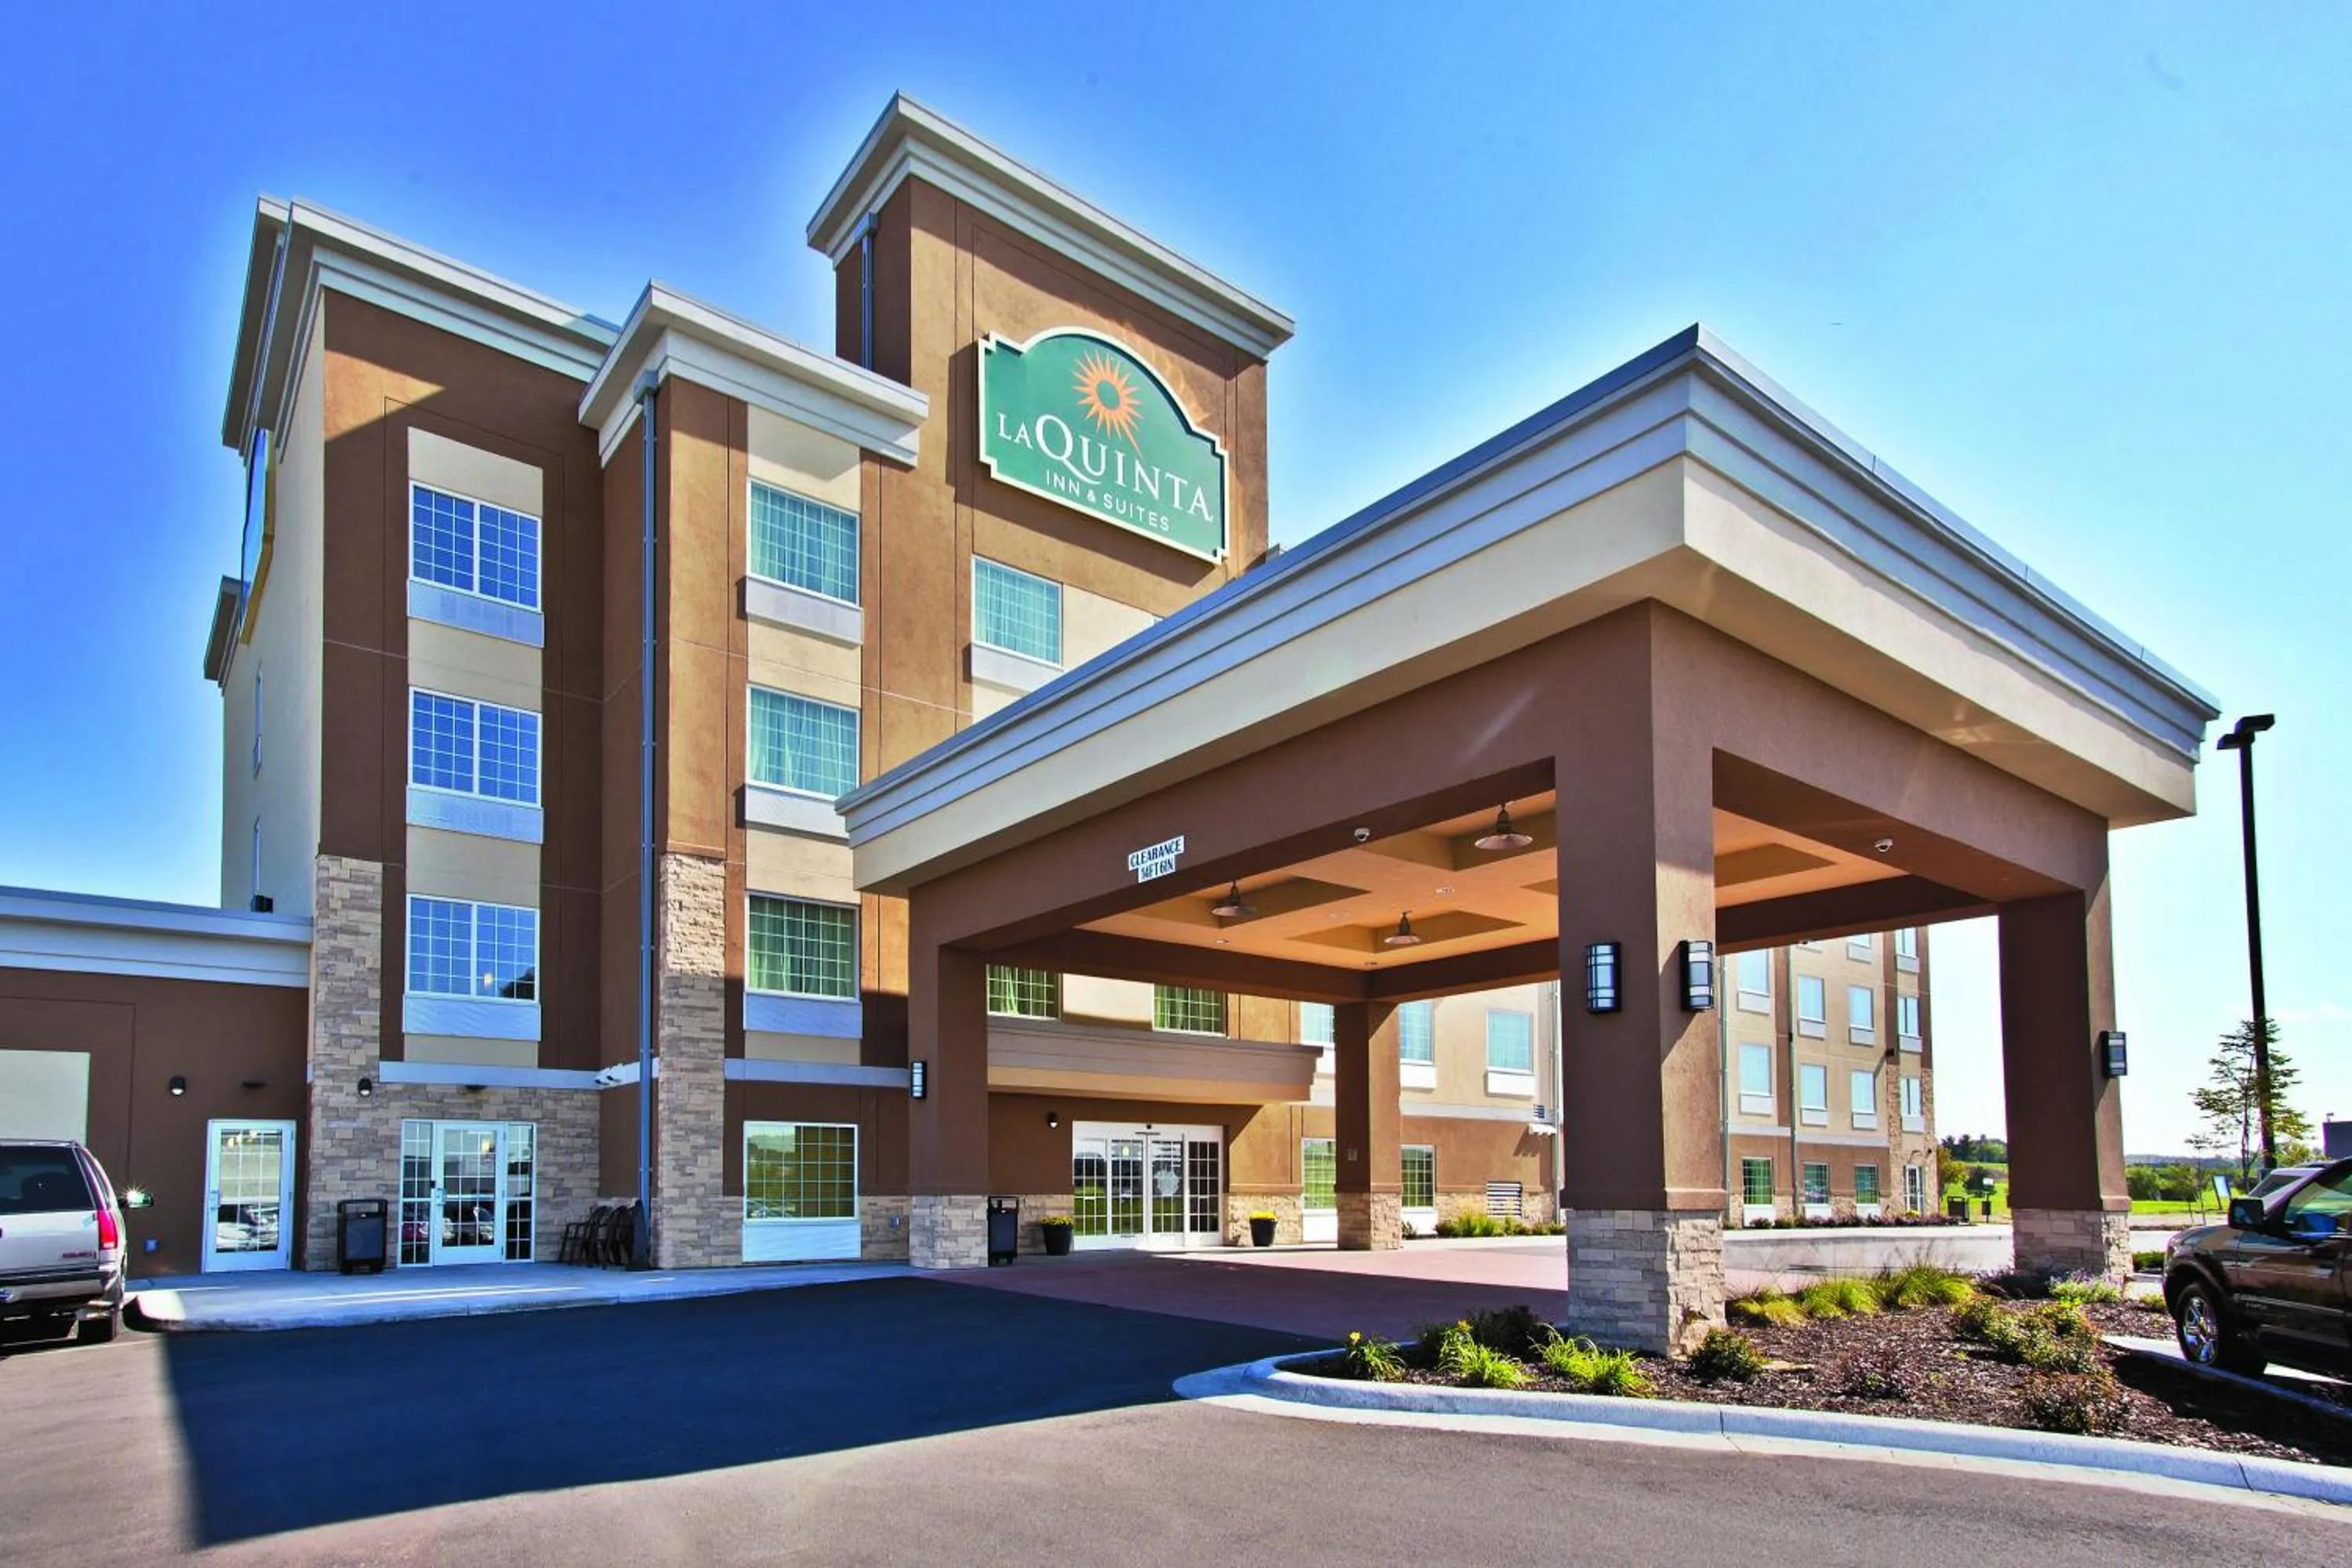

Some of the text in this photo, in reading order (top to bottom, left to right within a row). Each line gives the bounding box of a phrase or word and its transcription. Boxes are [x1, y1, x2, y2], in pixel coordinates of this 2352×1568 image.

[997, 412, 1214, 523] LA QUINTA
[1046, 469, 1170, 532] INN & SUITES
[1130, 838, 1181, 868] CLEARANCE
